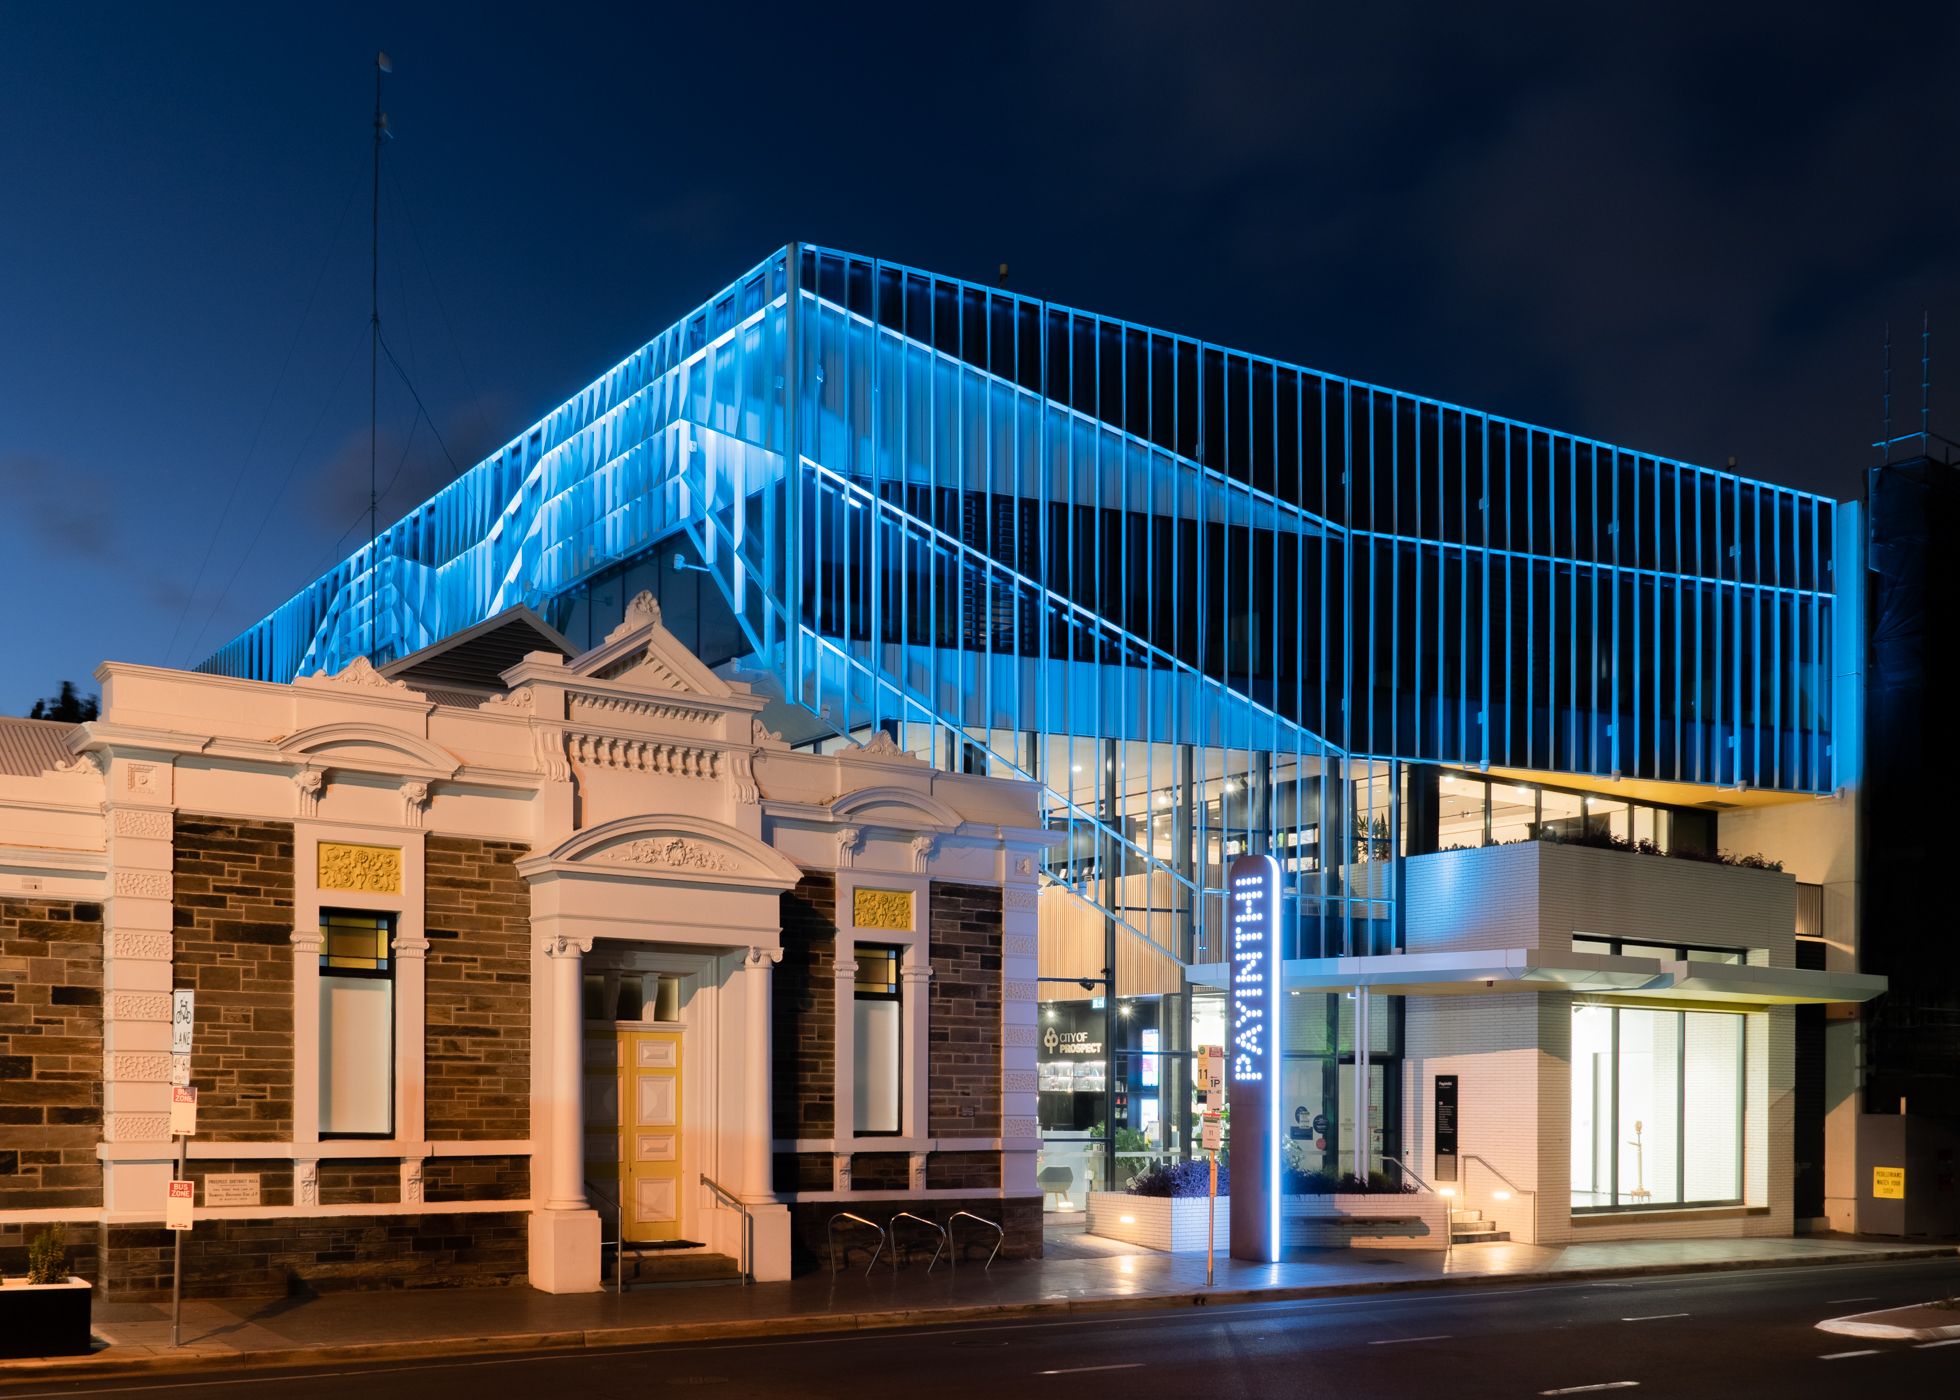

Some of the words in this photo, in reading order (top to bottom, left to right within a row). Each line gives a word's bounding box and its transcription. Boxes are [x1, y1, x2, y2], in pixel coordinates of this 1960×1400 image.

[1235, 876, 1263, 1081] PAYINTHI
[174, 1032, 191, 1045] LANE
[1060, 1033, 1076, 1043] CITY
[1076, 1032, 1088, 1043] OF
[1060, 1043, 1102, 1053] PROSPECT
[1199, 1069, 1207, 1079] 11
[1210, 1079, 1220, 1087] 1P
